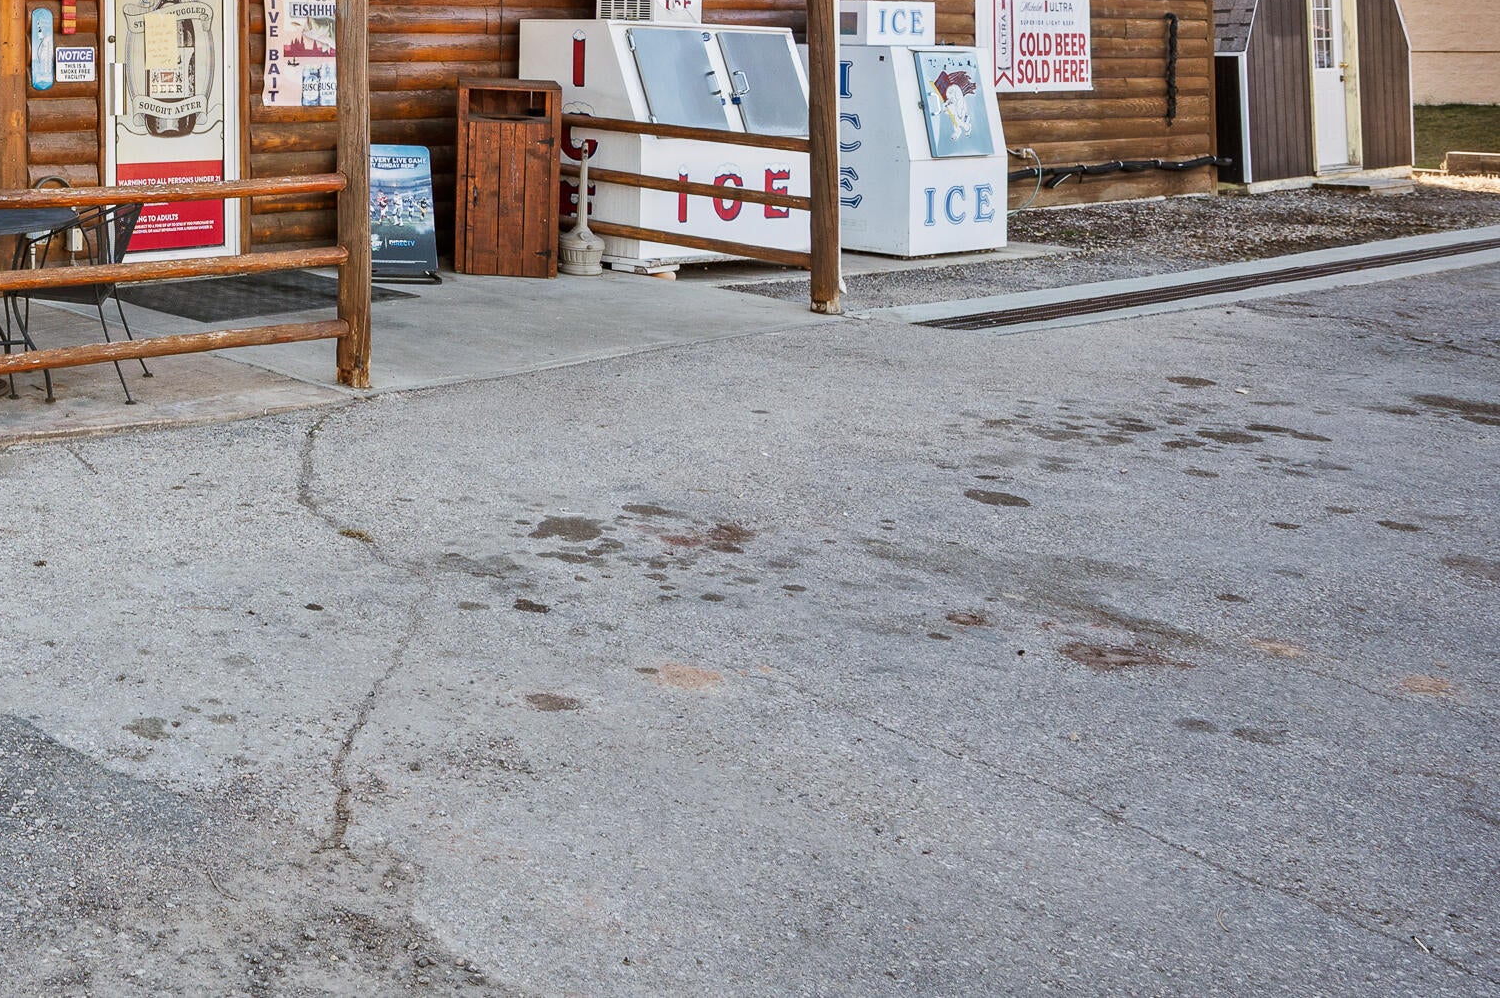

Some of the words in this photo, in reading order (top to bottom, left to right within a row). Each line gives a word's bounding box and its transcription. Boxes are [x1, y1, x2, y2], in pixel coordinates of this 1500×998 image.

[168, 7, 206, 16] UGGLED
[1049, 1, 1074, 12] ULTRA
[878, 9, 925, 36] ICE
[1019, 32, 1052, 57] COLD
[1055, 33, 1087, 56] BEER
[58, 50, 92, 61] NOTICE
[267, 49, 280, 102] BAIT
[1017, 59, 1051, 84] SOLD
[1053, 59, 1089, 83] HERE!
[151, 84, 183, 93] BEER
[302, 83, 319, 91] BUSC
[318, 82, 337, 91] BUSC
[139, 101, 173, 115] SOUGHT
[174, 101, 202, 115] AFTER
[117, 178, 147, 187] WARNING
[148, 178, 156, 186] TO
[156, 177, 167, 185] ALL
[167, 176, 194, 184] PERSONS
[194, 175, 215, 183] UNDER
[677, 162, 791, 223] ICE
[924, 183, 995, 226] ICE
[148, 214, 156, 222] TO
[156, 213, 179, 222] ADULTS
[388, 239, 416, 247] DIRECTV
